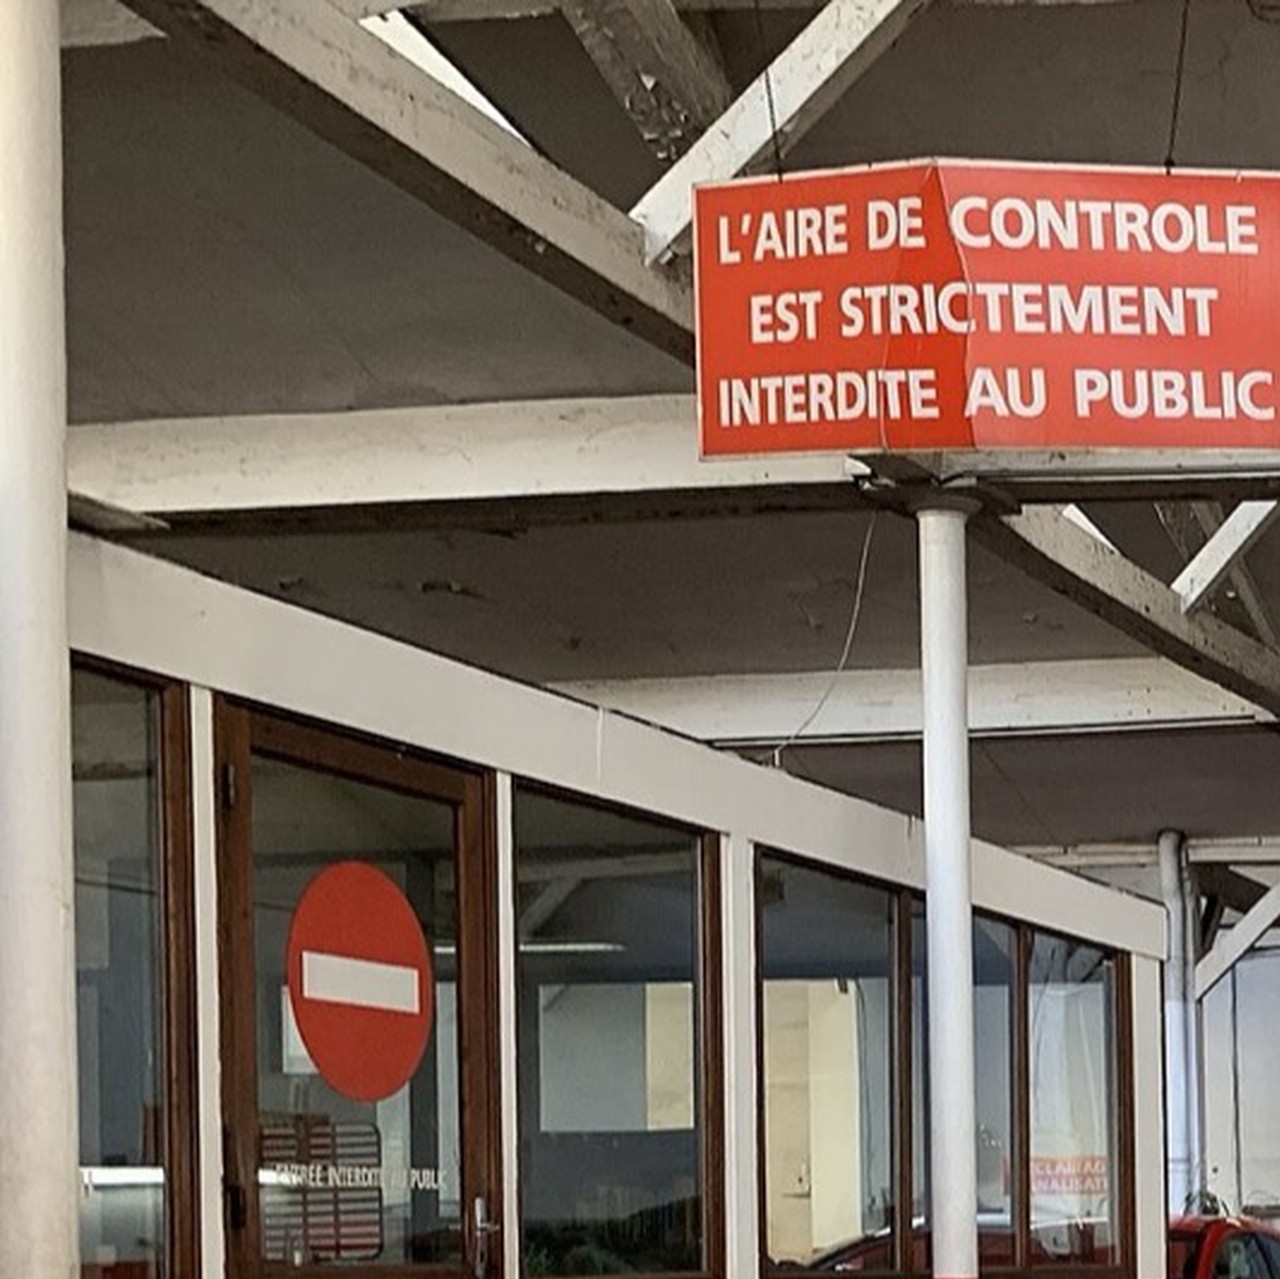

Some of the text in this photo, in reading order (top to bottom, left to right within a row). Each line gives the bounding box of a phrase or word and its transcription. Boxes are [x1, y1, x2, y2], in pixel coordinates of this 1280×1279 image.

[717, 196, 1259, 265] L'AIRE DE CONTROLE
[750, 283, 1219, 343] EST STRICTEMENT
[719, 368, 1275, 427] INTERDITE AU PUBLIC
[327, 1164, 387, 1189] INTERDIT
